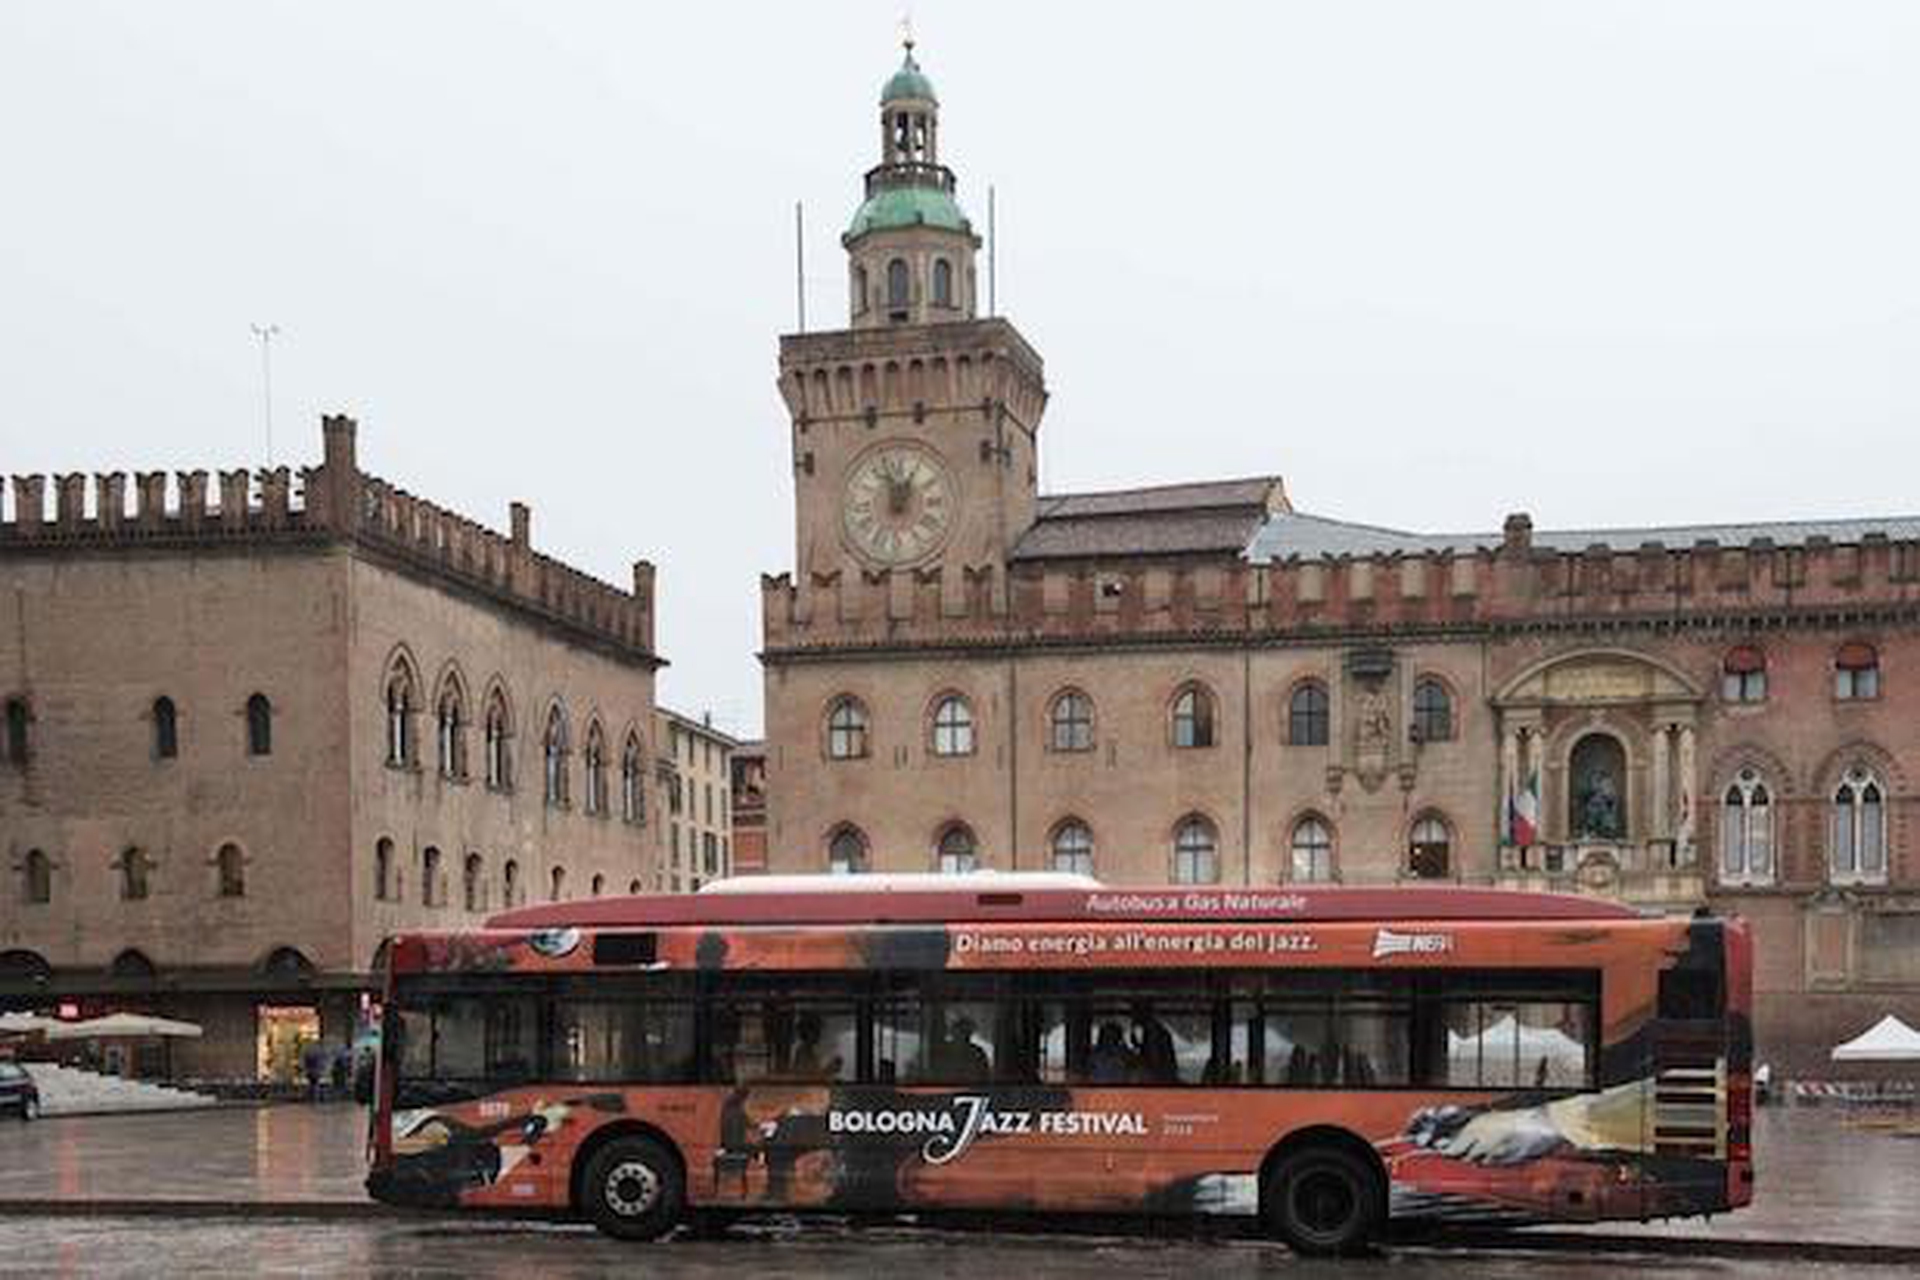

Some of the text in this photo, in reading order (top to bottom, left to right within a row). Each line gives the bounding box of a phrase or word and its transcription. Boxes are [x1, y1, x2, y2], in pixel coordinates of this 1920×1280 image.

[1087, 895, 1307, 912] Autobus a Gas Naturale
[956, 933, 1023, 951] Diamo
[1028, 935, 1106, 955] energia
[1113, 932, 1224, 954] all'energia
[1229, 932, 1264, 951] del
[828, 1109, 954, 1133] BOLOGNA
[922, 1096, 1032, 1163] JAZZ
[1039, 1111, 1149, 1135] FESTIVAL
